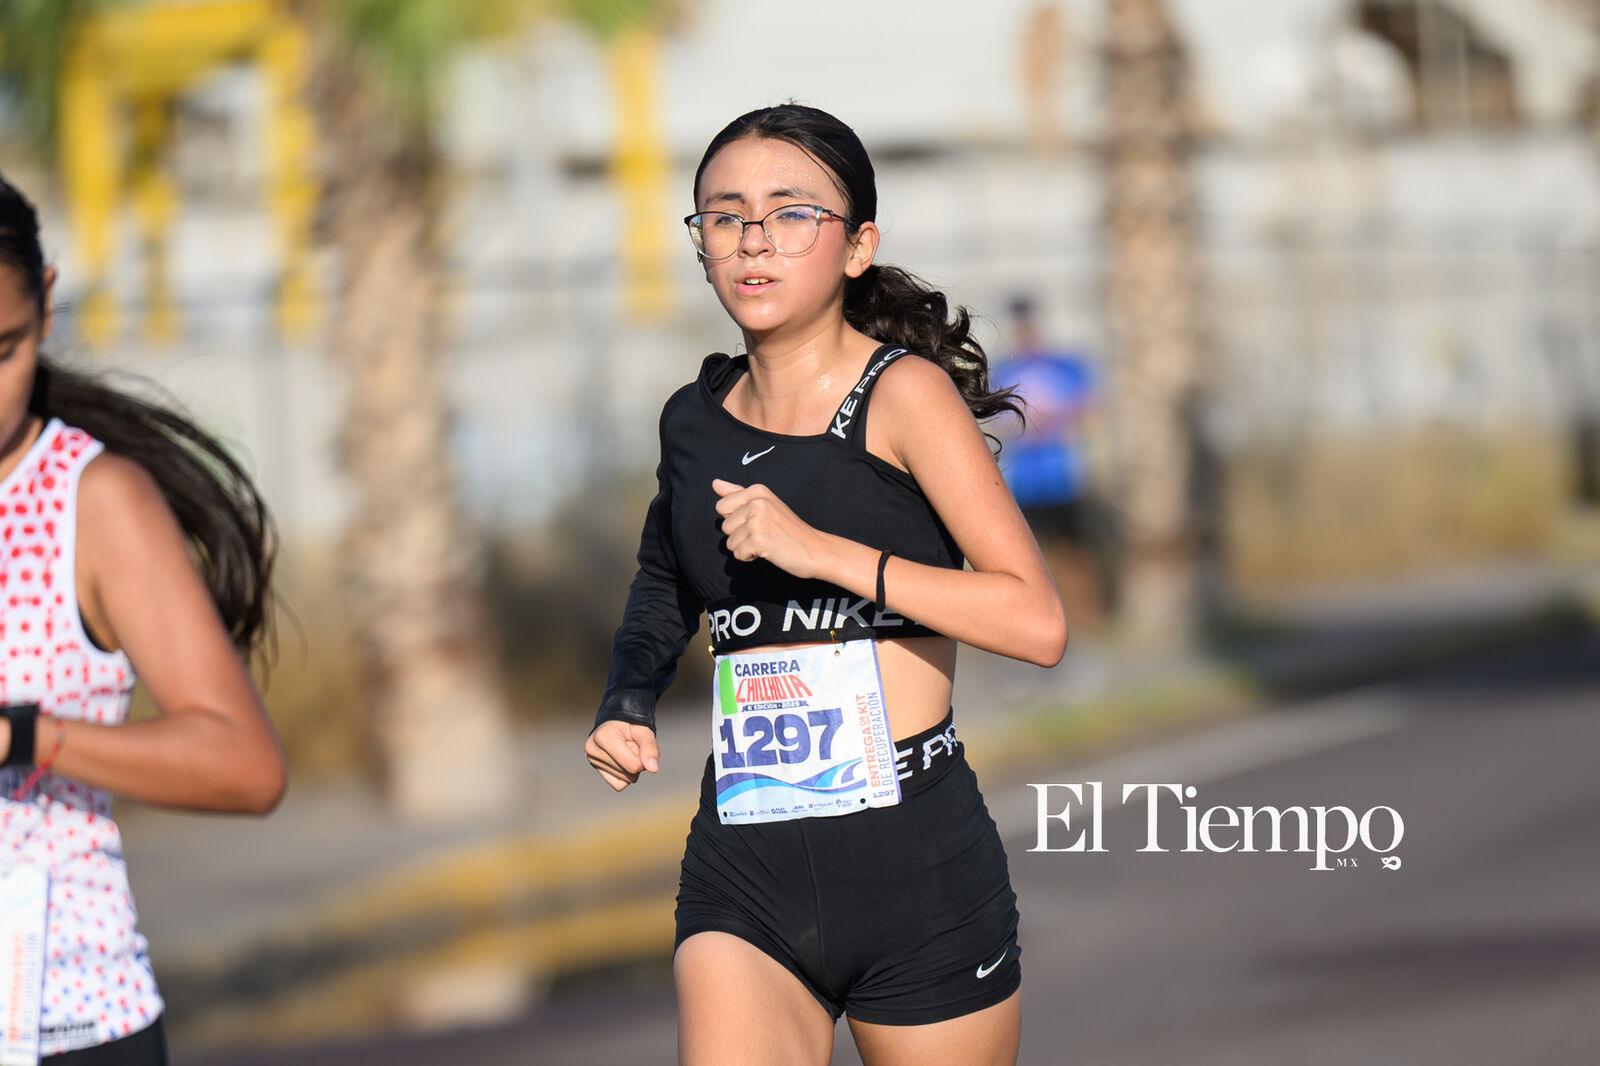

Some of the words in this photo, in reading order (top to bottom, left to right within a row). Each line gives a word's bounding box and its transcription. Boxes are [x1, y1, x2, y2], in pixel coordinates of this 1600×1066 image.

[854, 348, 907, 394] PRO
[735, 659, 800, 677] CARRERA
[856, 694, 868, 714] KIT
[719, 707, 844, 769] 1297
[862, 727, 881, 788] ENTREGA
[881, 772, 894, 787] DE
[873, 789, 895, 799] 1297
